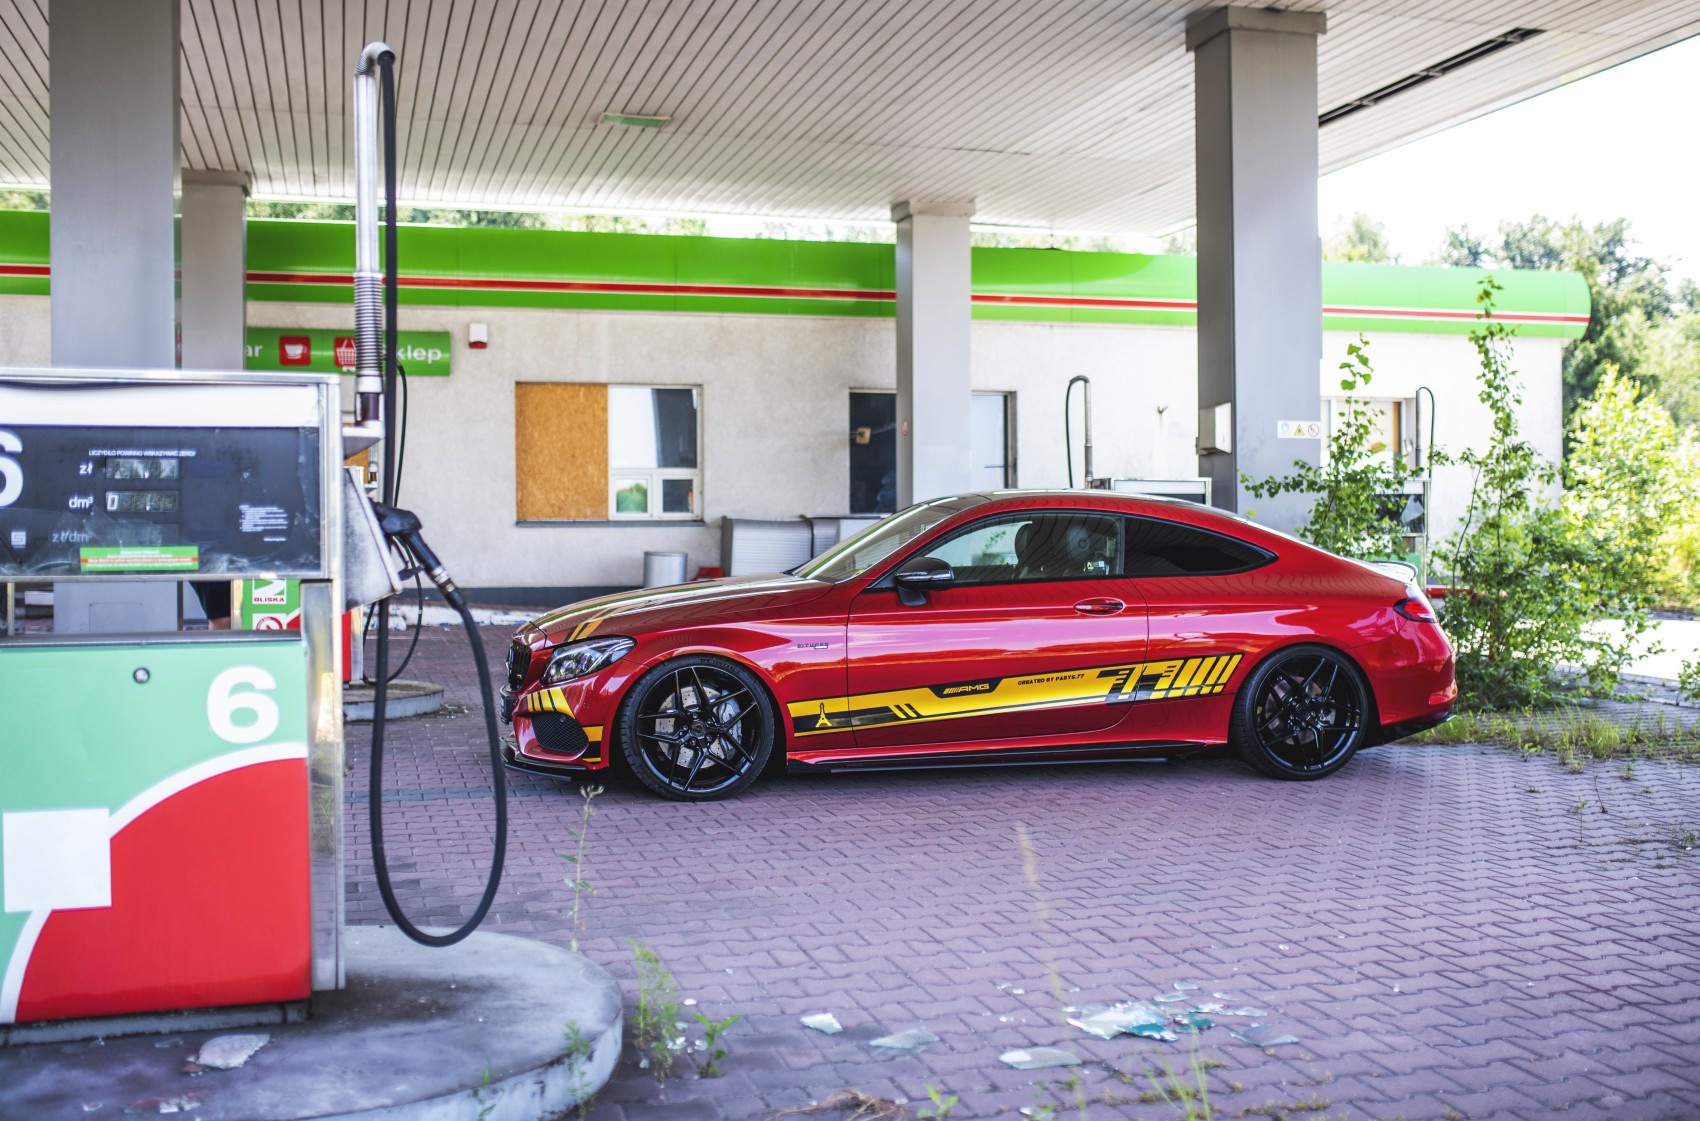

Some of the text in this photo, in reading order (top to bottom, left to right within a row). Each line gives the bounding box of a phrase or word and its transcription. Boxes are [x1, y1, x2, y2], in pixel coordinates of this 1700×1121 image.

[246, 344, 262, 357] ar
[382, 345, 442, 363] klep
[1017, 678, 1046, 686] CREATED
[1055, 673, 1085, 681] PARYS.77
[957, 684, 989, 693] AMG
[207, 665, 279, 743] 6
